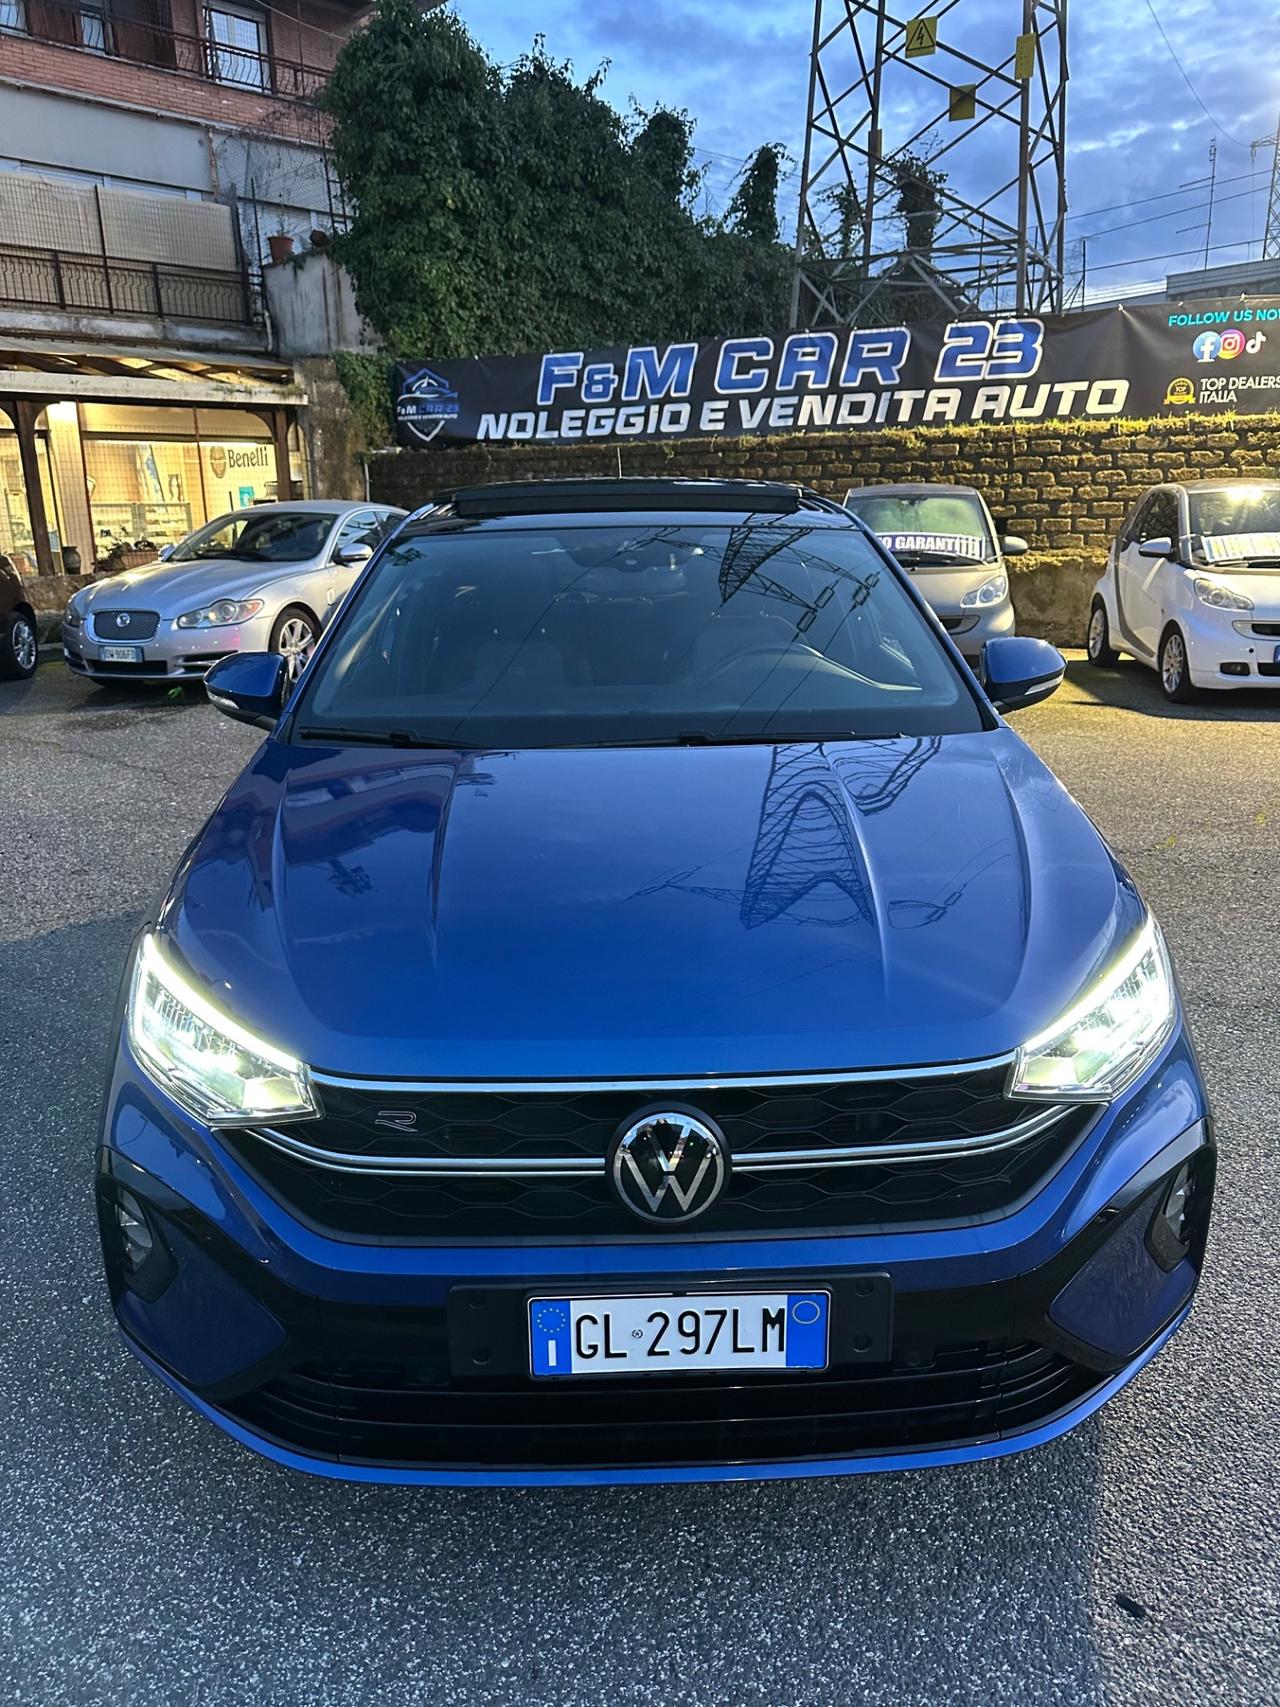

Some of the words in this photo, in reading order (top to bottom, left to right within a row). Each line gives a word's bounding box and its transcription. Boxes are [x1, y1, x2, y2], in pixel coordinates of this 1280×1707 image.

[1168, 311, 1230, 327] FOLLOW
[1233, 309, 1253, 322] US
[536, 343, 699, 406] F&M
[713, 327, 911, 396] CAR
[934, 317, 1044, 383] 23
[1200, 377, 1227, 391] TOP
[1199, 390, 1238, 404] ITALIA
[476, 402, 691, 441] NOLEGGIO
[700, 400, 730, 431] E
[738, 386, 969, 431] VENDITA
[971, 379, 1130, 421] AUTO
[227, 446, 269, 468] Benelli
[575, 1313, 628, 1359] GL
[646, 1307, 786, 1357] 297LM
